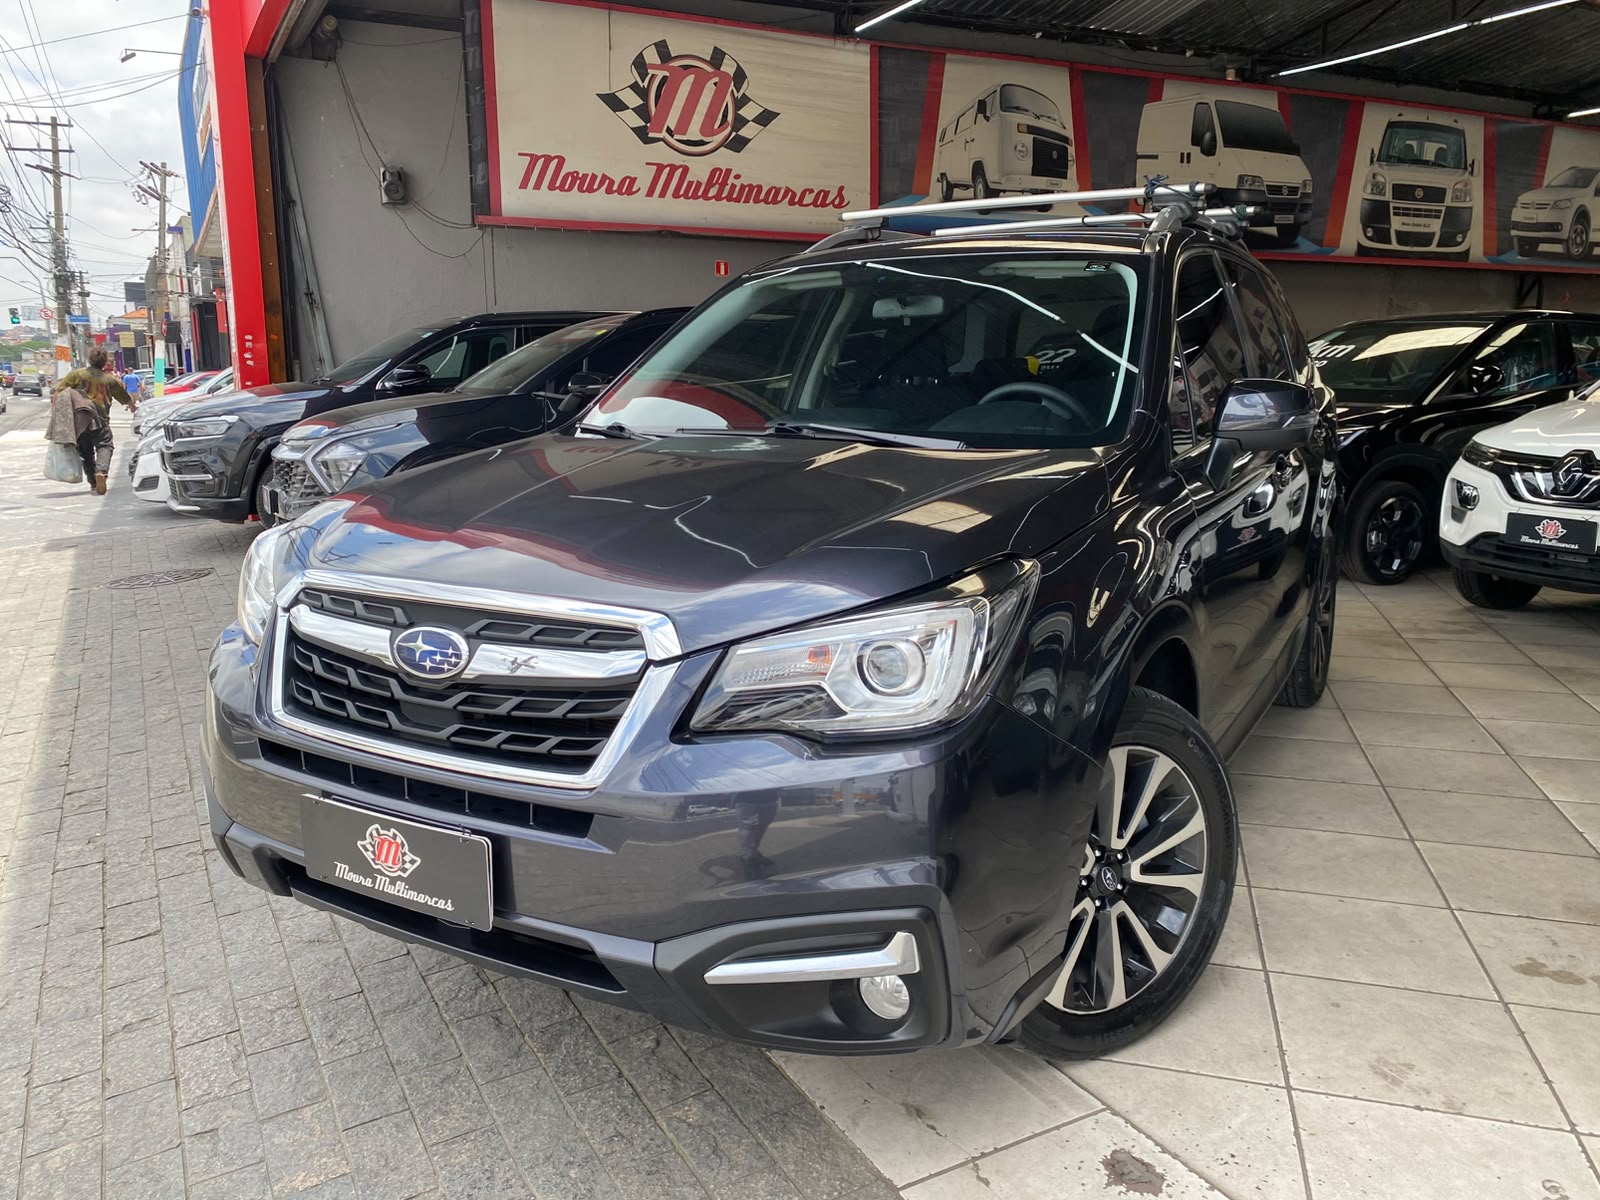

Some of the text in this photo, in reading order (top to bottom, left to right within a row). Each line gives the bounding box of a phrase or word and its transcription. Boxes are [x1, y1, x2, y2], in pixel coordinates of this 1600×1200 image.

[647, 62, 733, 141] M
[518, 152, 850, 209] Moura Multimarcas
[373, 835, 401, 867] M
[333, 861, 455, 911] Moura Multimarcas
